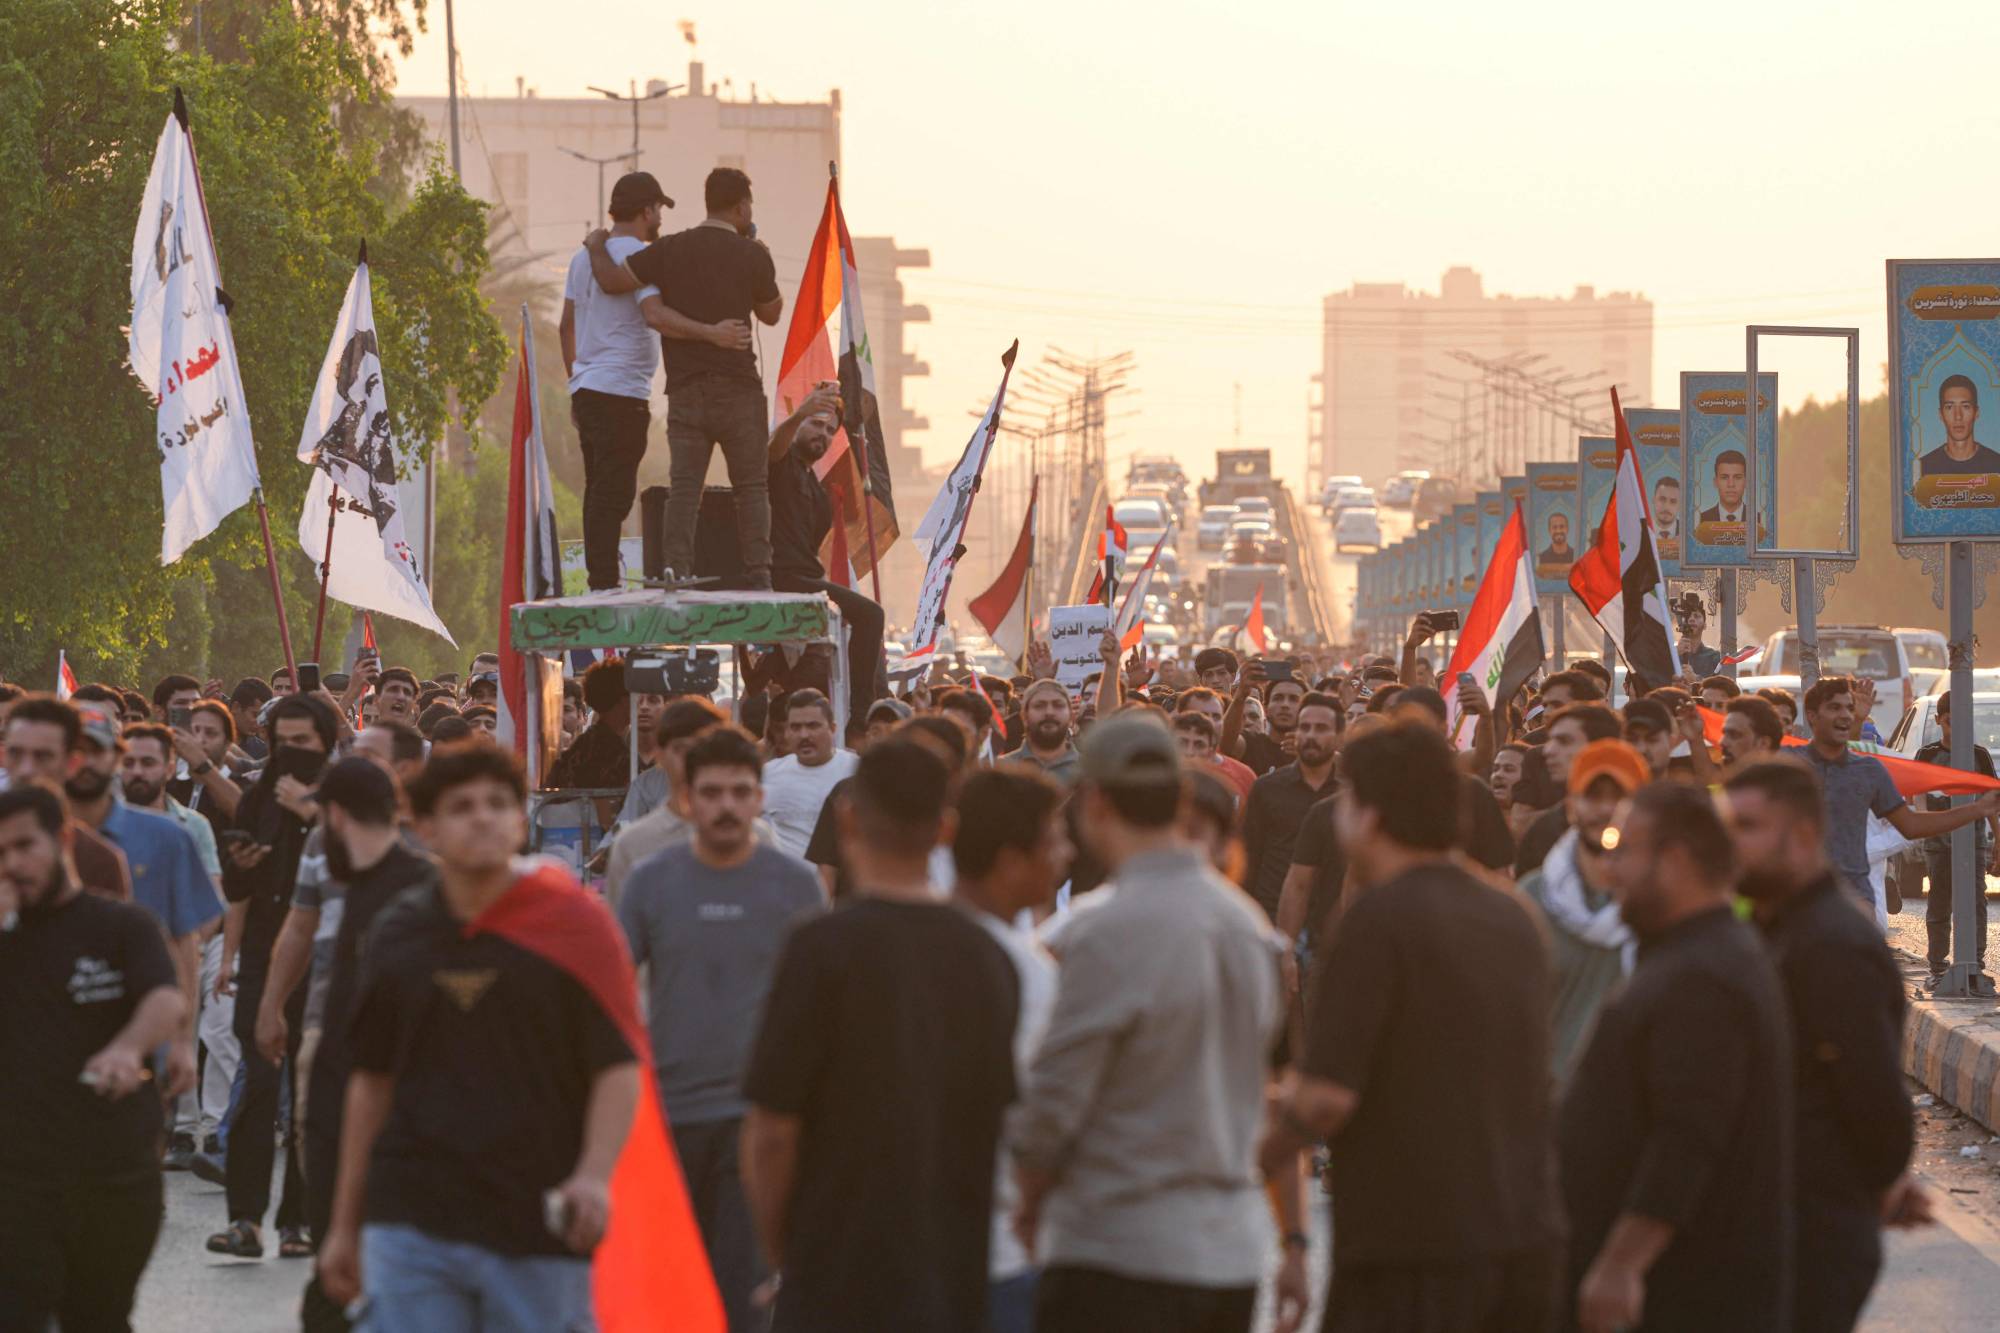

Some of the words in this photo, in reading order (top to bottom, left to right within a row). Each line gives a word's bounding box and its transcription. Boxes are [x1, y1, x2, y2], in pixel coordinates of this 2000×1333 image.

[1914, 295, 1948, 310] تشرين
[1949, 292, 1968, 310] ثورة
[1970, 493, 1995, 504] محمد
[523, 607, 636, 642] النجف
[665, 604, 750, 642] تشرين
[1052, 622, 1083, 640] الدين
